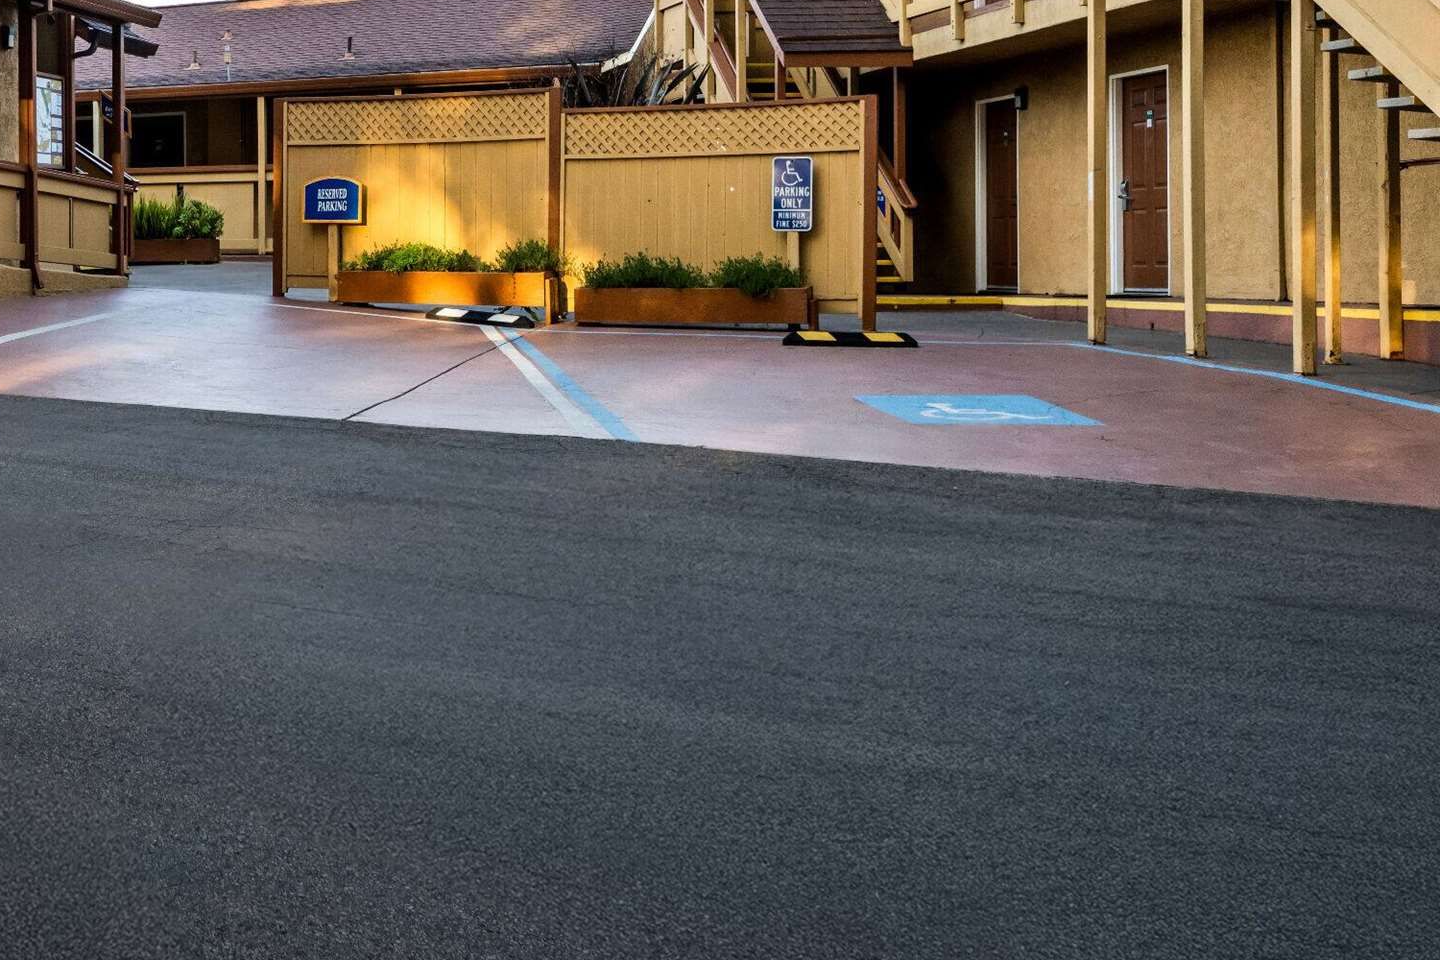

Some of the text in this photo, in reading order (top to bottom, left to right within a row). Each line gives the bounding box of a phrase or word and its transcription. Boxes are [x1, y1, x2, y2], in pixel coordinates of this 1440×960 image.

[317, 188, 347, 199] RESERVED
[774, 186, 810, 197] PARKING
[317, 200, 348, 212] PARKING
[781, 198, 803, 209] ONLY
[792, 220, 808, 228] $250
